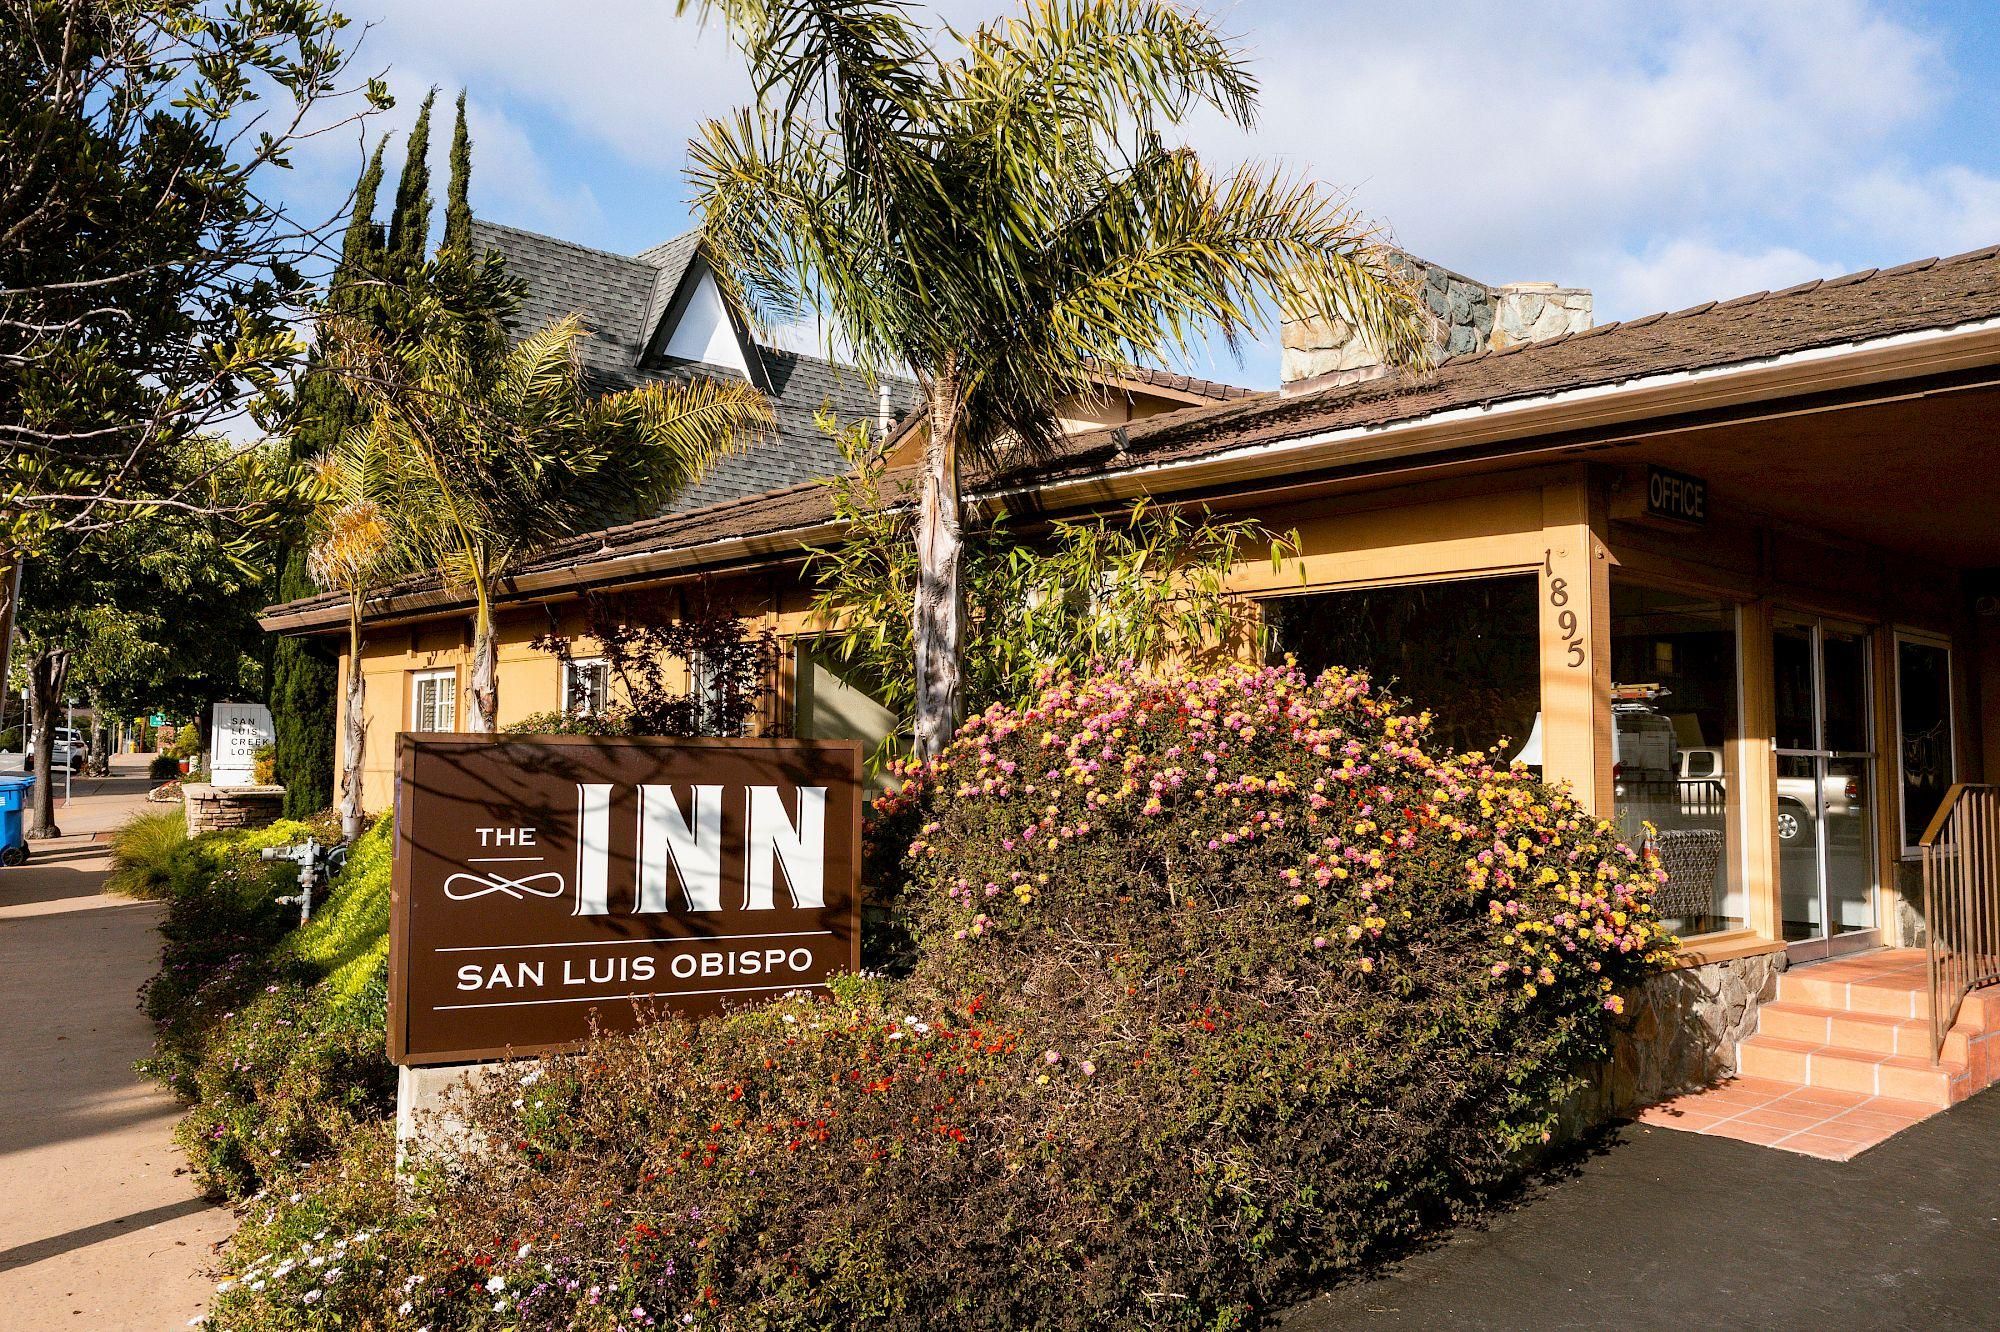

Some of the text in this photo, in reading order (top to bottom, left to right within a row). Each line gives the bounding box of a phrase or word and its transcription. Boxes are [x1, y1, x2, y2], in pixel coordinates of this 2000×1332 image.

[1650, 472, 1704, 518] OFFICE
[1544, 548, 1585, 668] 1895
[231, 728, 258, 736] LUIS
[232, 717, 255, 725] SAN
[231, 738, 269, 746] CREEK
[231, 748, 256, 756] LOD
[475, 782, 829, 917] THE INN
[456, 947, 814, 991] SAN LUIS OBISPO
